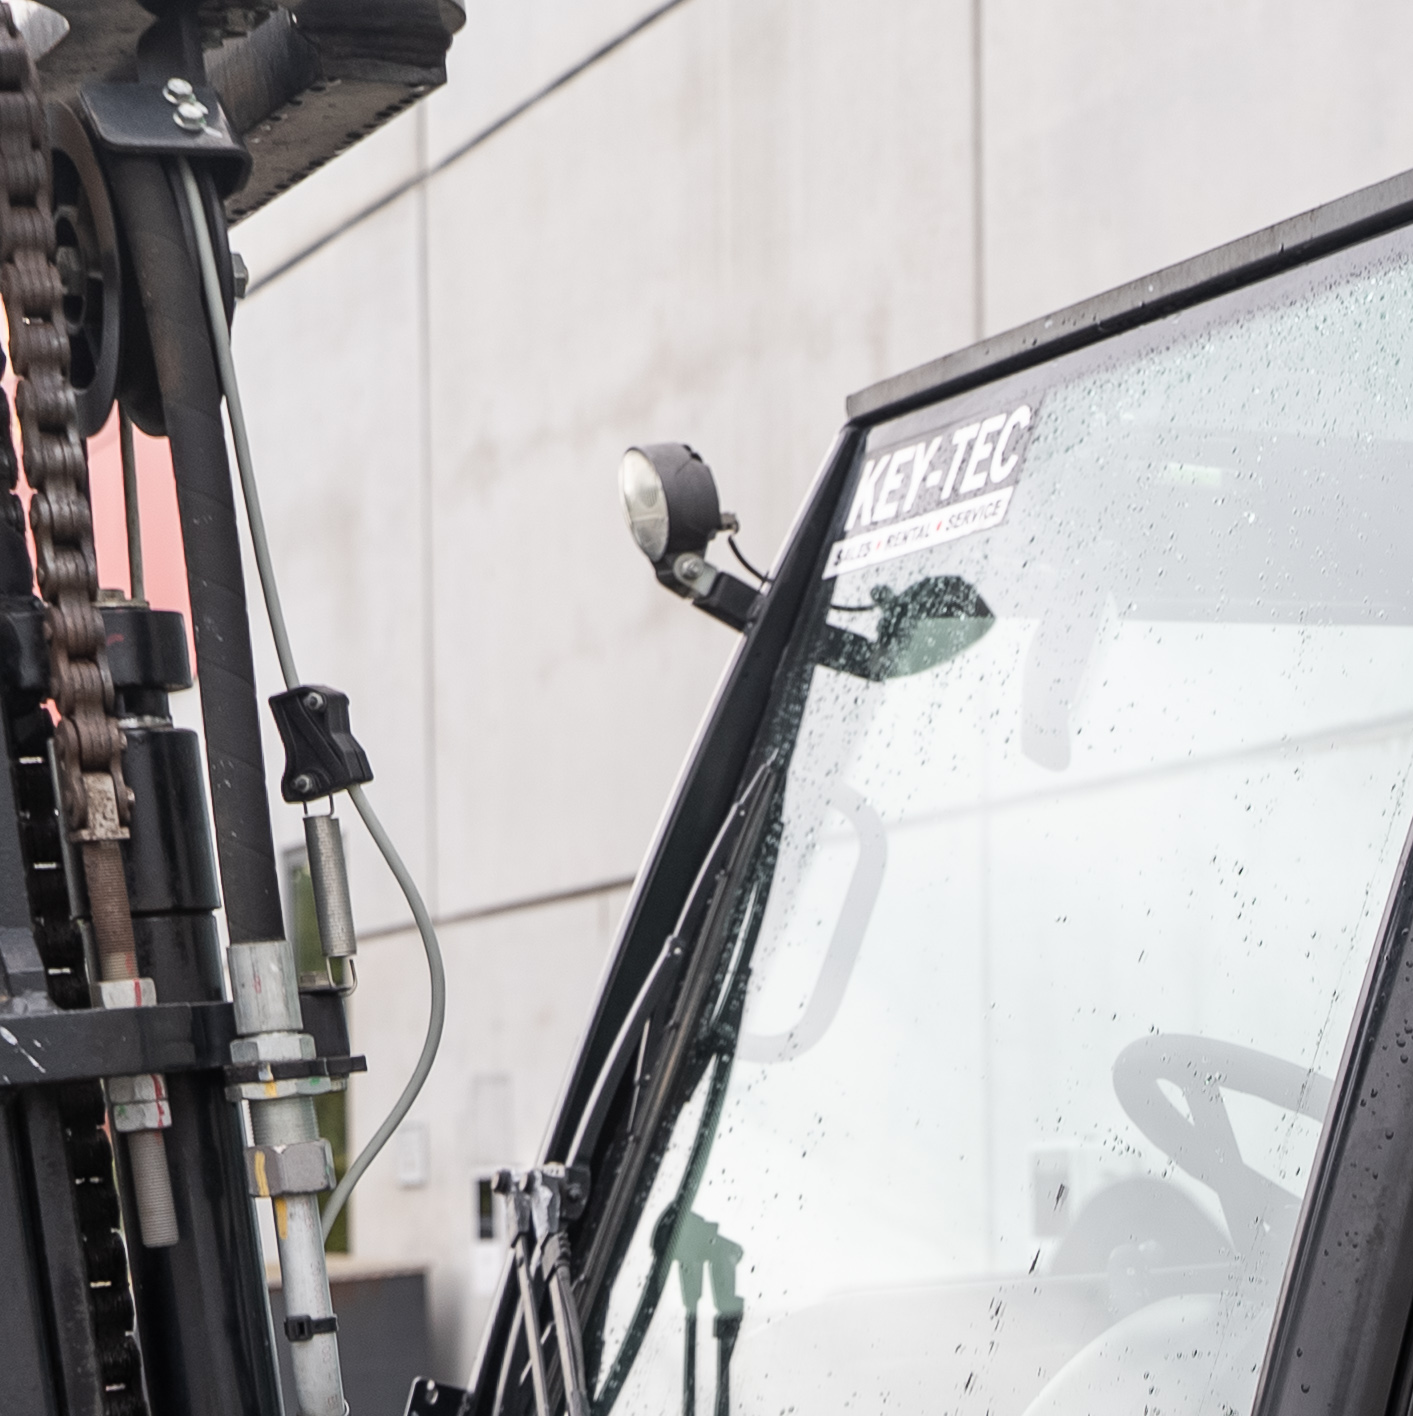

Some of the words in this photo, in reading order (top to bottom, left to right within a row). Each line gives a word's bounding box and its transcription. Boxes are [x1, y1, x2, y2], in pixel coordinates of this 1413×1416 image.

[844, 405, 1031, 531] KEY-TEC
[886, 523, 930, 547] RENTAL
[946, 499, 1002, 531] SERVICE
